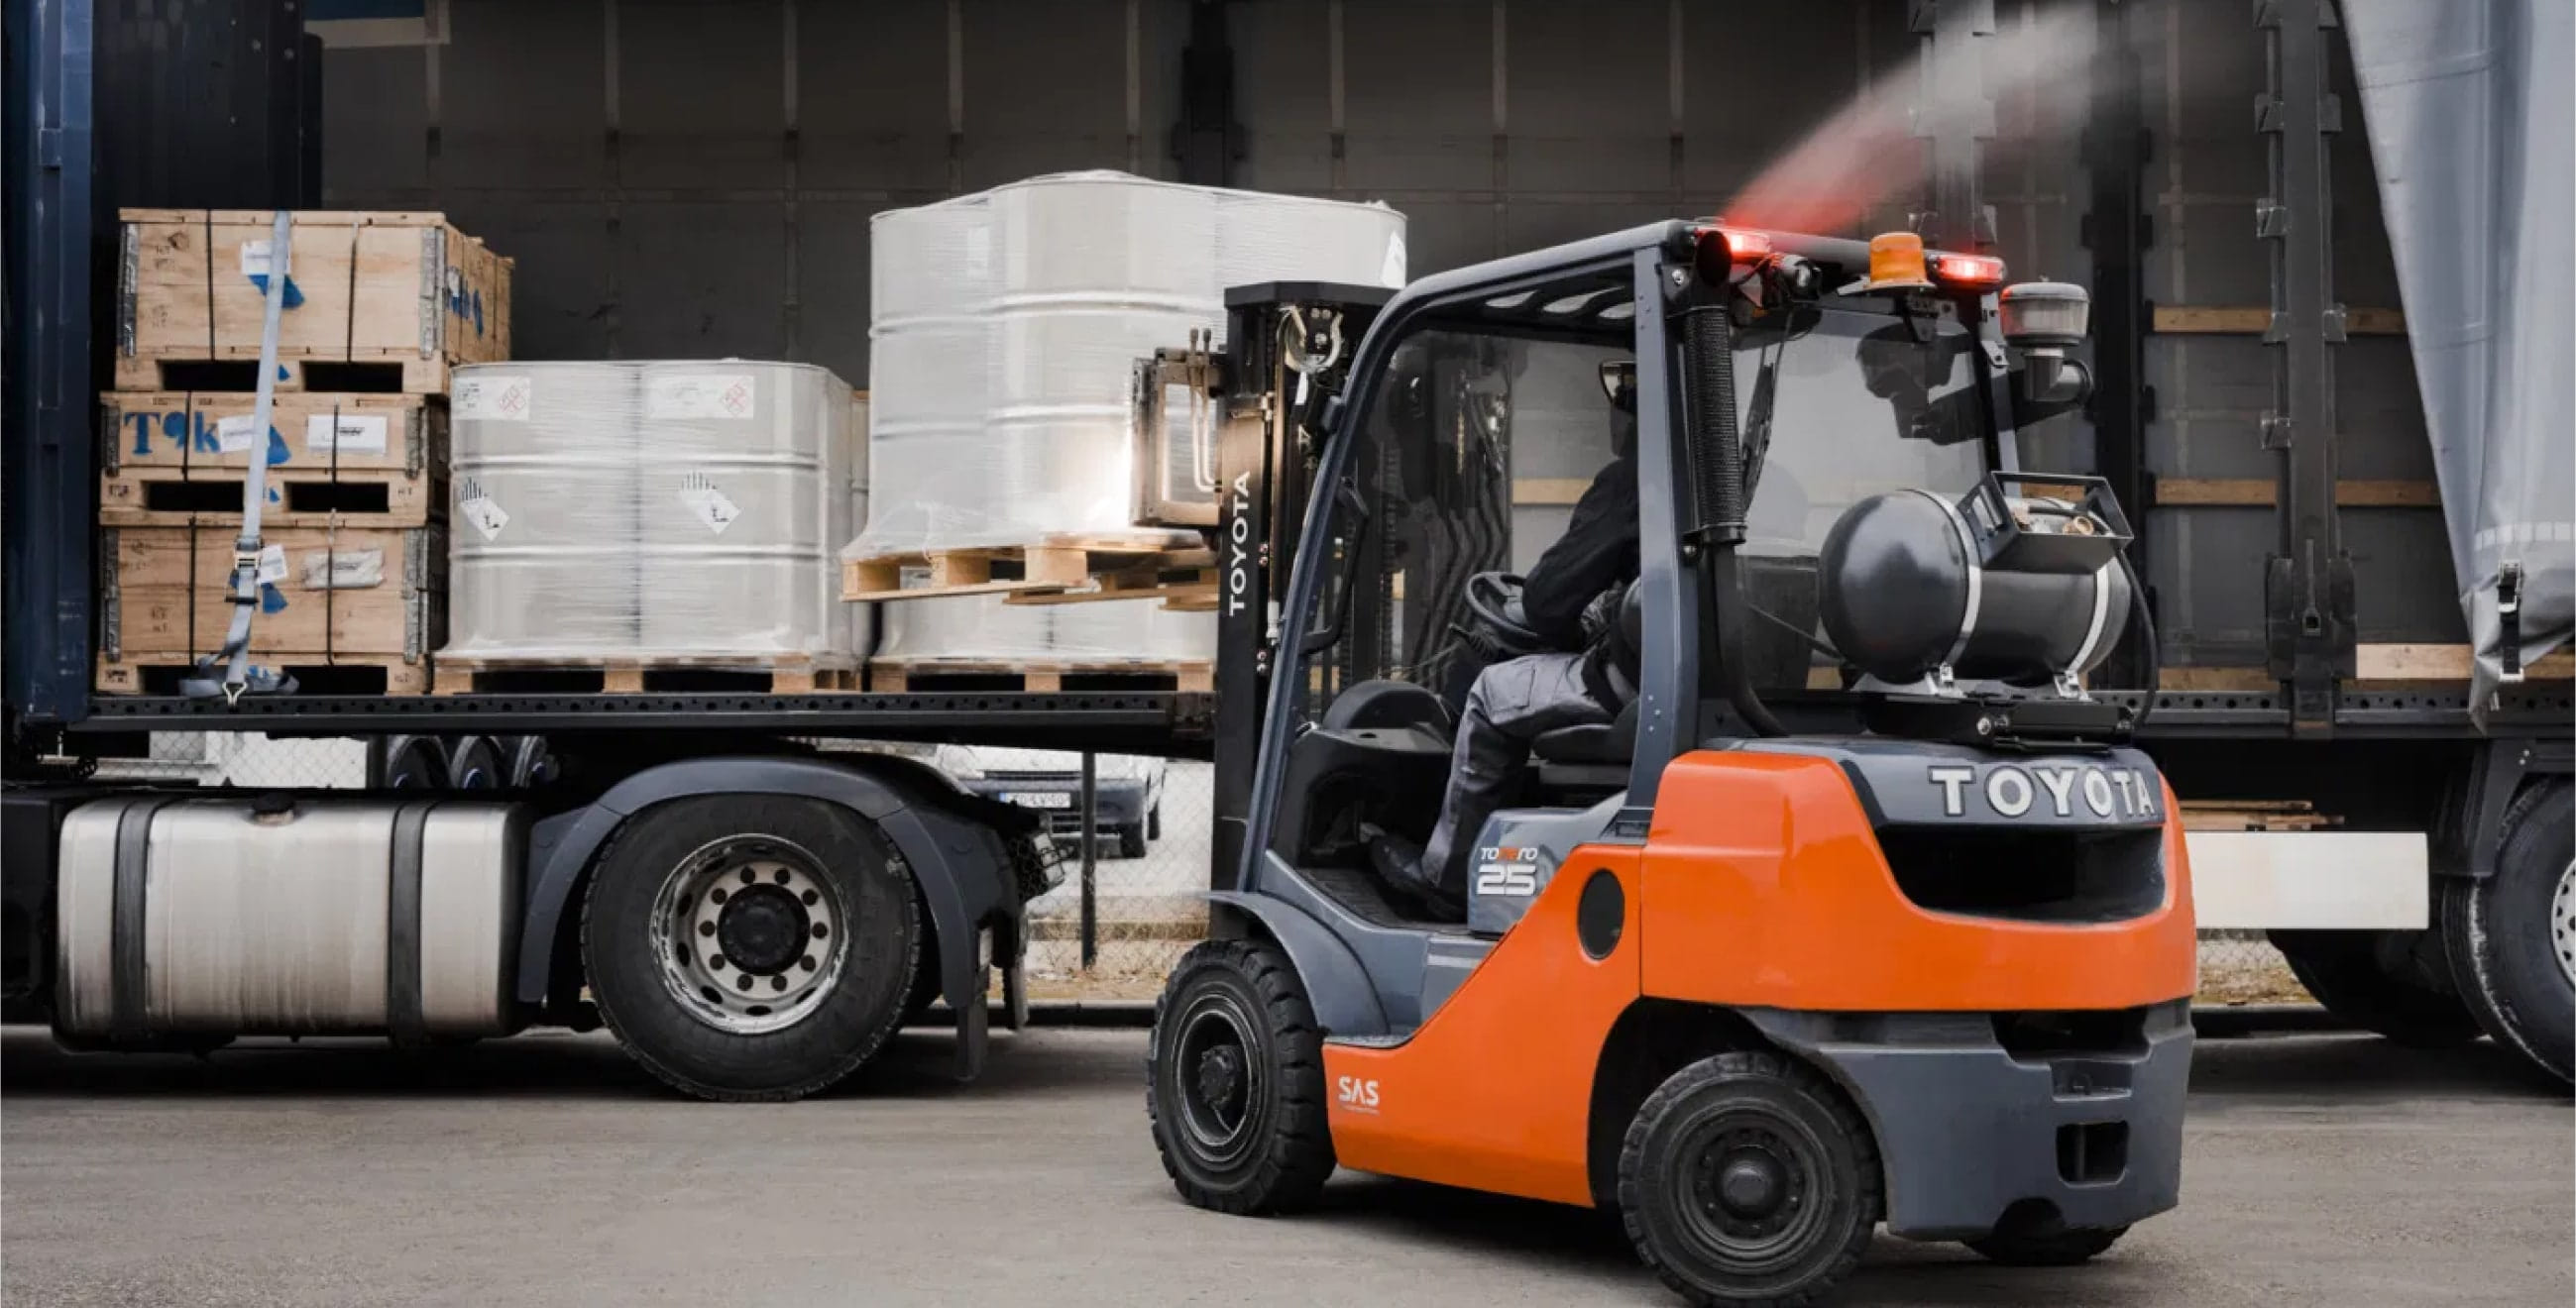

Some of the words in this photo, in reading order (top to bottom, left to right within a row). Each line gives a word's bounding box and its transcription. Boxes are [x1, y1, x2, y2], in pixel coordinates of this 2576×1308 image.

[1229, 471, 1250, 617] TOYOTA
[1929, 765, 2156, 818] TOYOTA
[1477, 864, 1536, 896] 25
[1338, 1076, 1379, 1106] SAS
